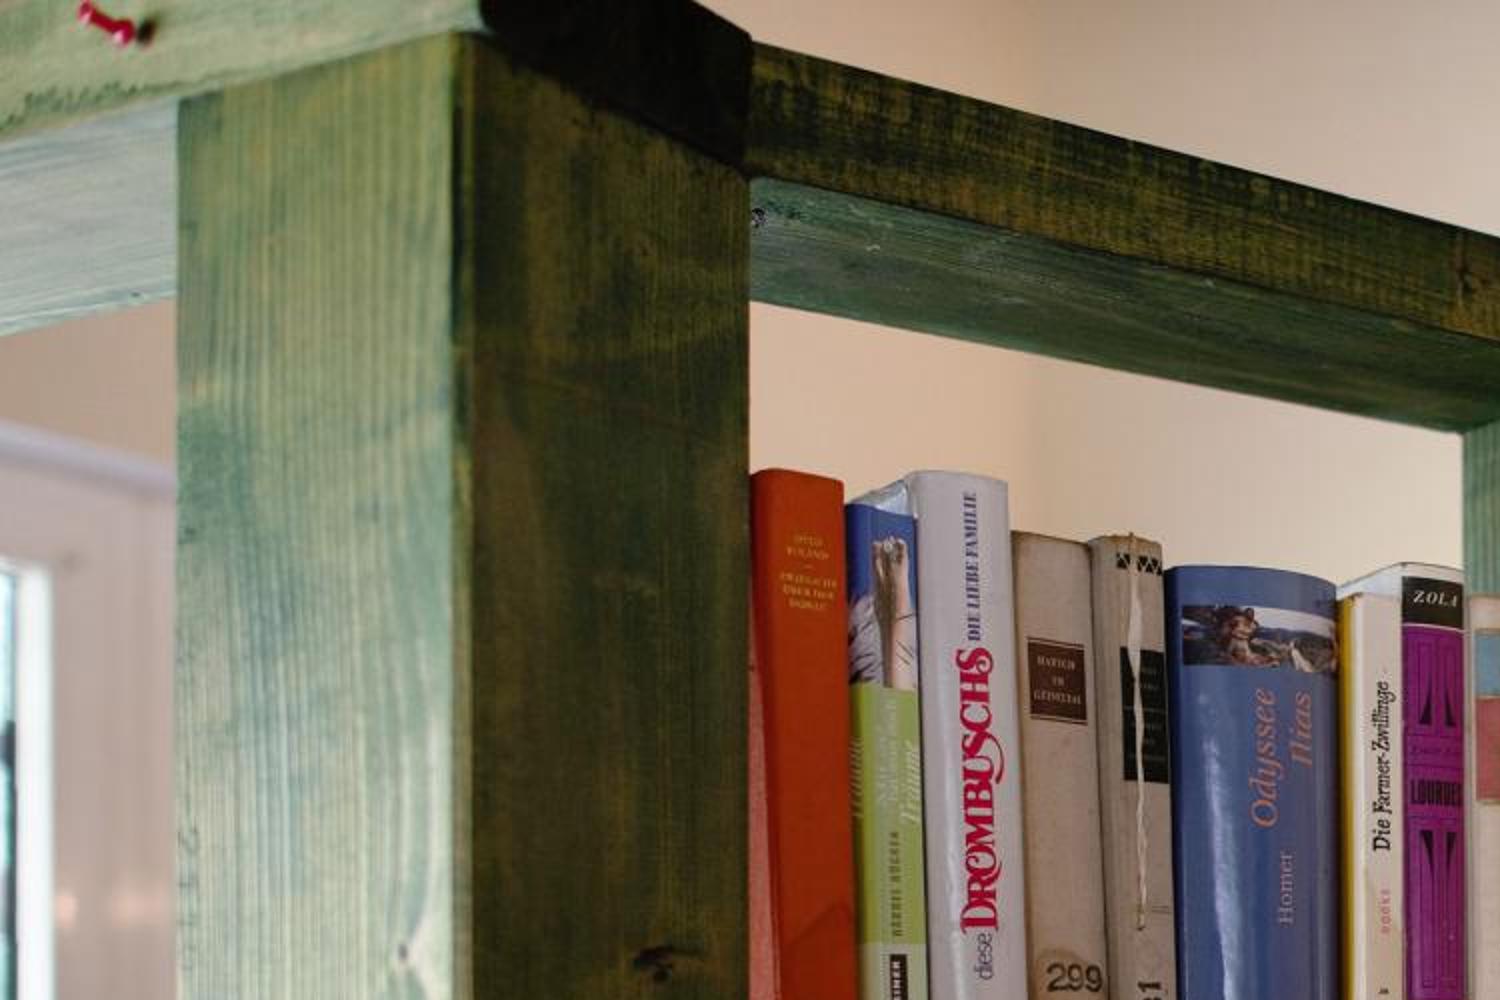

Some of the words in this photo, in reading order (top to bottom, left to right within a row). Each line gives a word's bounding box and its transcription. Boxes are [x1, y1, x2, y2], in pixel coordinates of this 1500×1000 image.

[963, 490, 979, 557] FAMILIE
[965, 561, 980, 609] LIEBE
[966, 613, 981, 641] DIE
[1249, 687, 1281, 829] Odyssee
[1288, 691, 1313, 769] Ilias
[1371, 679, 1398, 815] Farmer-Zwillinge
[957, 647, 1004, 936] DROMBUSCHS
[1372, 817, 1392, 852] Die
[1277, 851, 1296, 925] Homer
[973, 933, 994, 981] diese
[1046, 962, 1104, 993] 299
